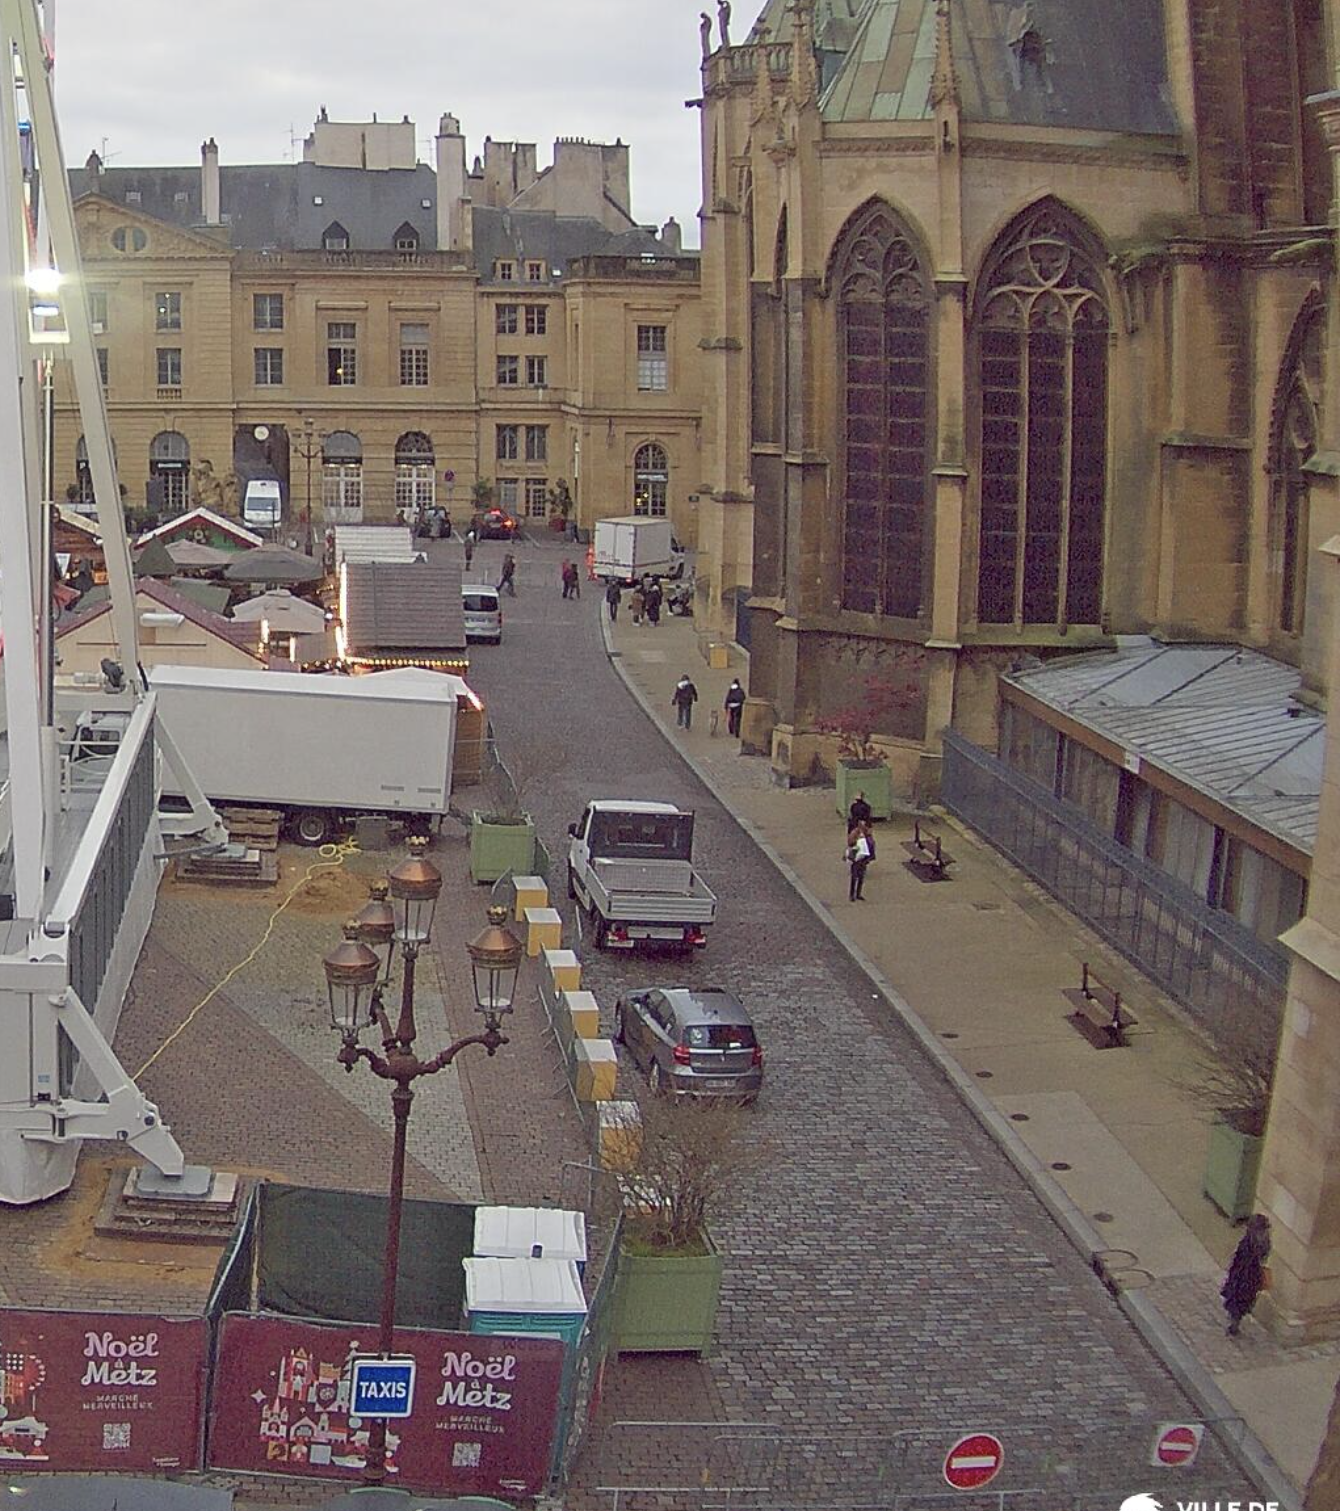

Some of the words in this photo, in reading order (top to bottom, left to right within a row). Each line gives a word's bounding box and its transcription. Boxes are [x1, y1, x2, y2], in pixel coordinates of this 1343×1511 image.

[83, 1332, 159, 1357] Noël
[81, 1361, 157, 1386] Metz
[441, 1352, 516, 1380] Noël
[359, 1382, 406, 1398] TAXIS
[436, 1381, 512, 1410] Metz
